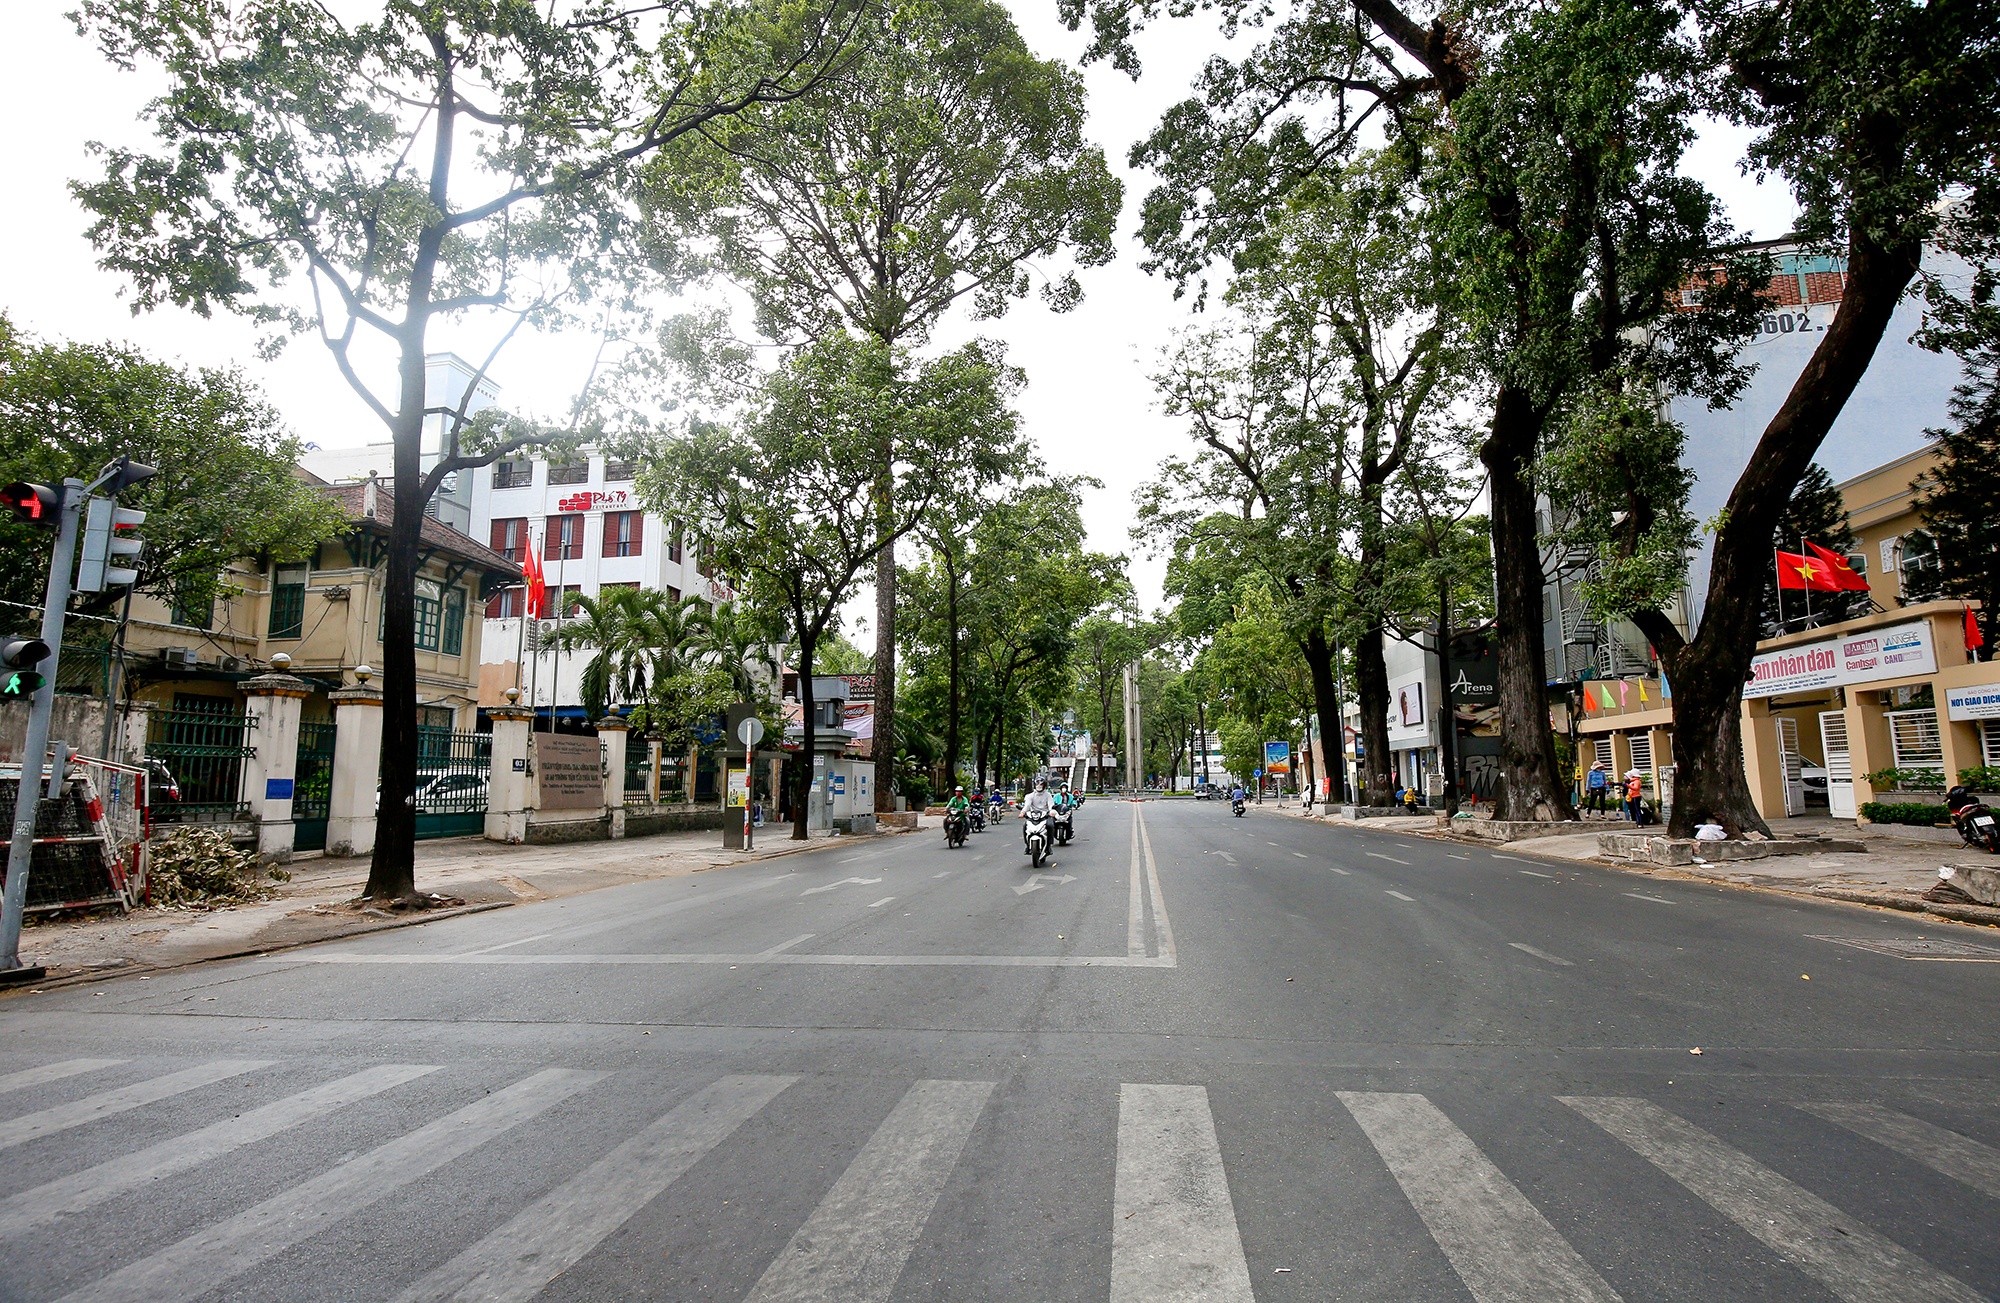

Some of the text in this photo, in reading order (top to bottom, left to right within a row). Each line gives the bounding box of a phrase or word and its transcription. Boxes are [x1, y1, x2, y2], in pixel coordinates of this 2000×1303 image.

[1771, 654, 1806, 678] nhân
[1807, 648, 1836, 672] dân
[1450, 669, 1493, 695] Arena
[1965, 696, 1982, 706] GIAO
